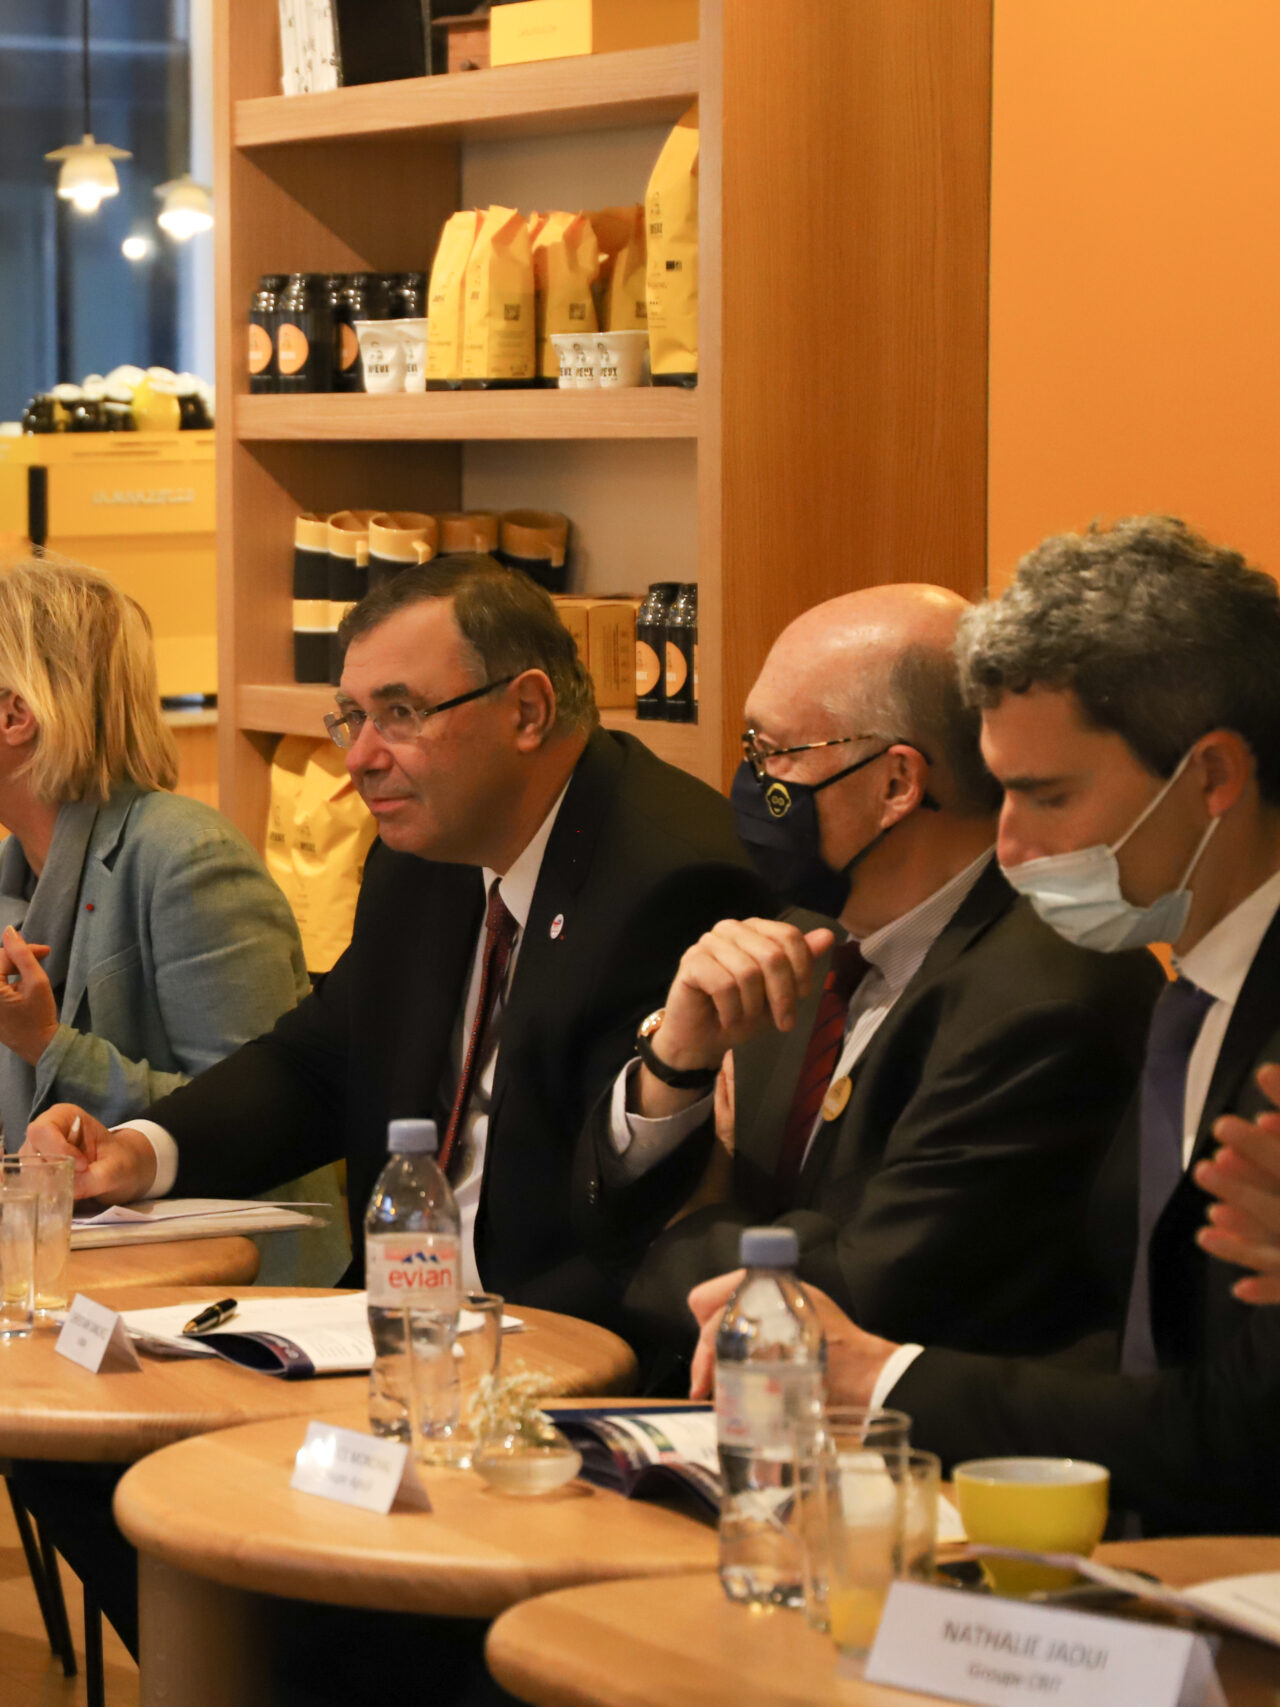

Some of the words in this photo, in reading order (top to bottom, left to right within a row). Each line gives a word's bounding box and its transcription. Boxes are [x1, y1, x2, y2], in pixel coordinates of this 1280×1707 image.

[388, 1266, 453, 1289] evian
[943, 1620, 1040, 1659] NATHALIE
[1046, 1639, 1110, 1671] JAOUI
[967, 1661, 1022, 1688] Groupe
